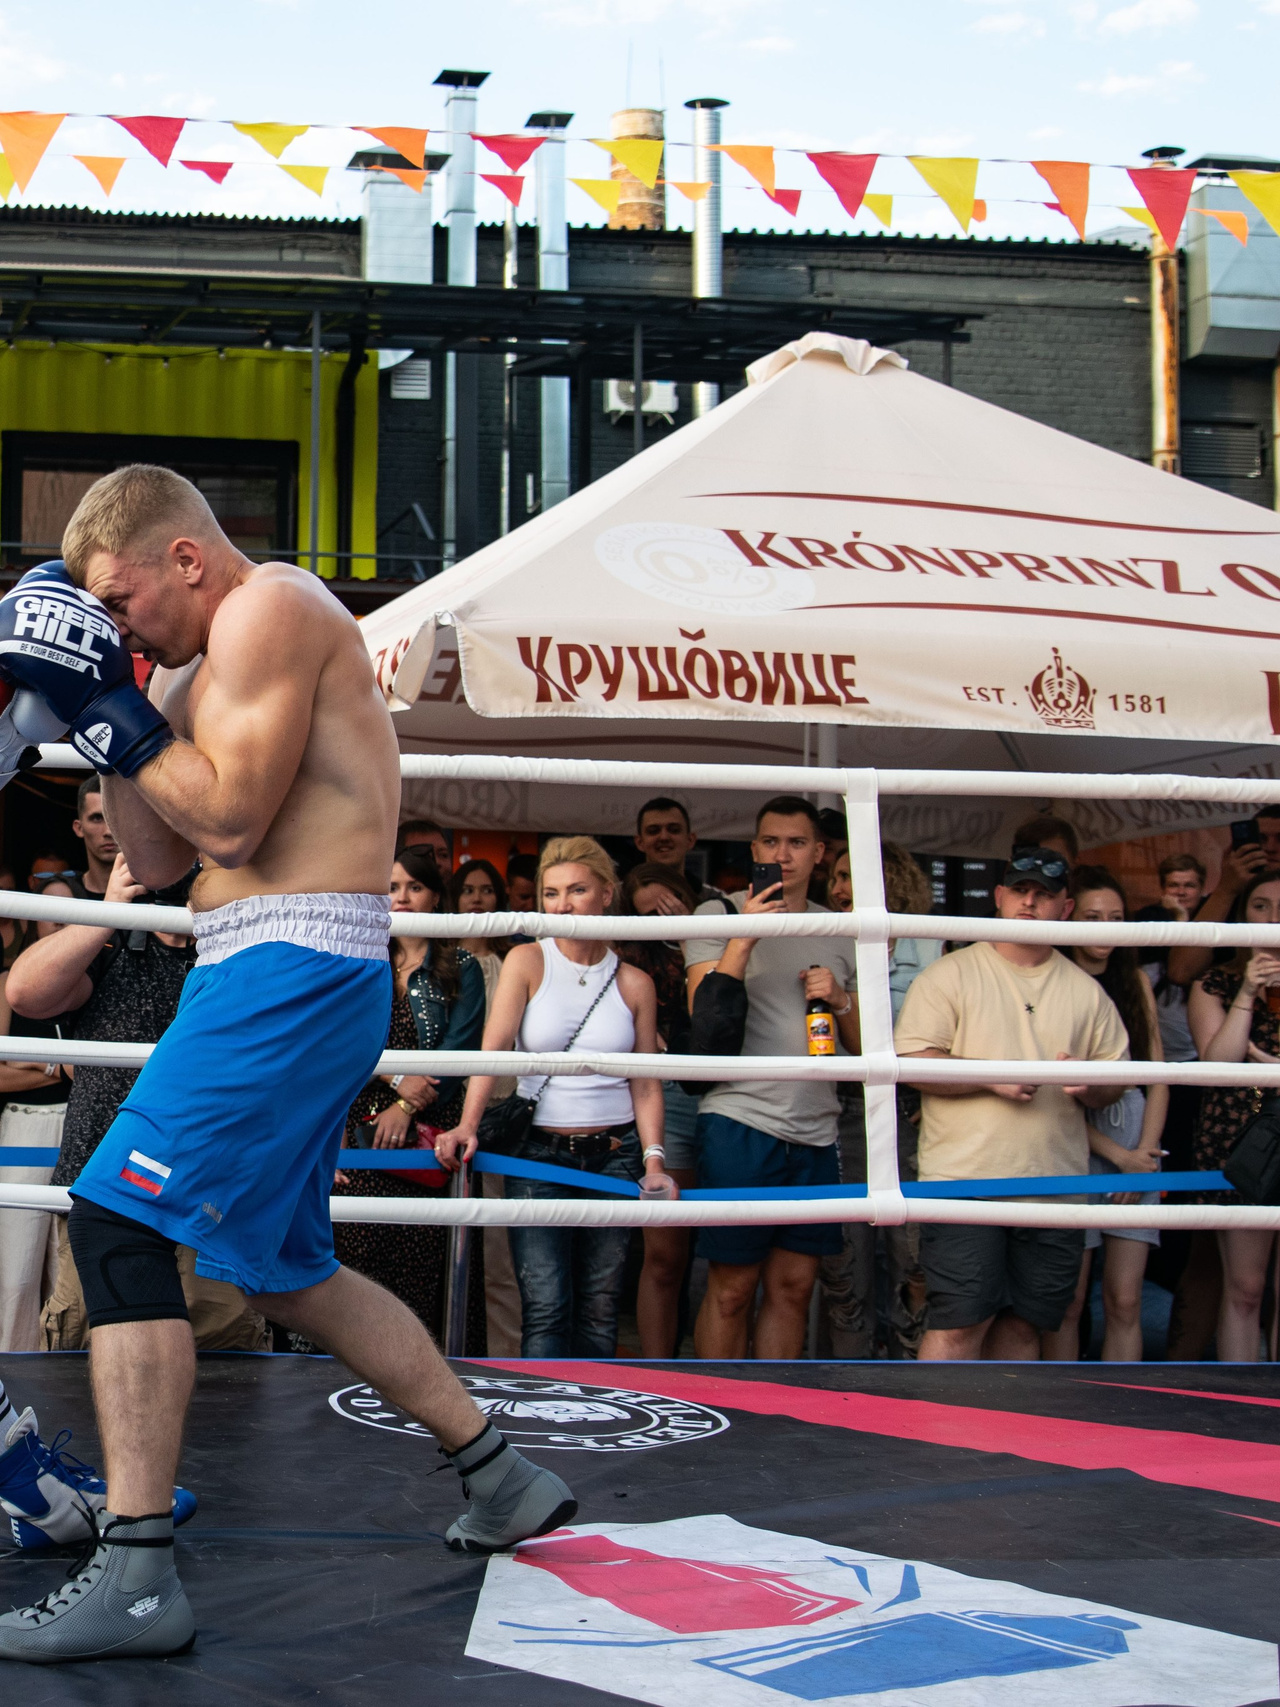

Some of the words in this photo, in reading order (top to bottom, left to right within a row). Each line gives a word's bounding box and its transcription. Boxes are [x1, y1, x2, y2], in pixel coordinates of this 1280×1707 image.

[13, 612, 103, 661] HILL
[14, 596, 120, 647] GREEN
[20, 642, 29, 652] BE
[29, 645, 47, 657] YOUR
[47, 649, 64, 661] BEST
[65, 655, 80, 668] SELF
[963, 686, 1017, 706] EST.
[1108, 694, 1166, 715] 1581
